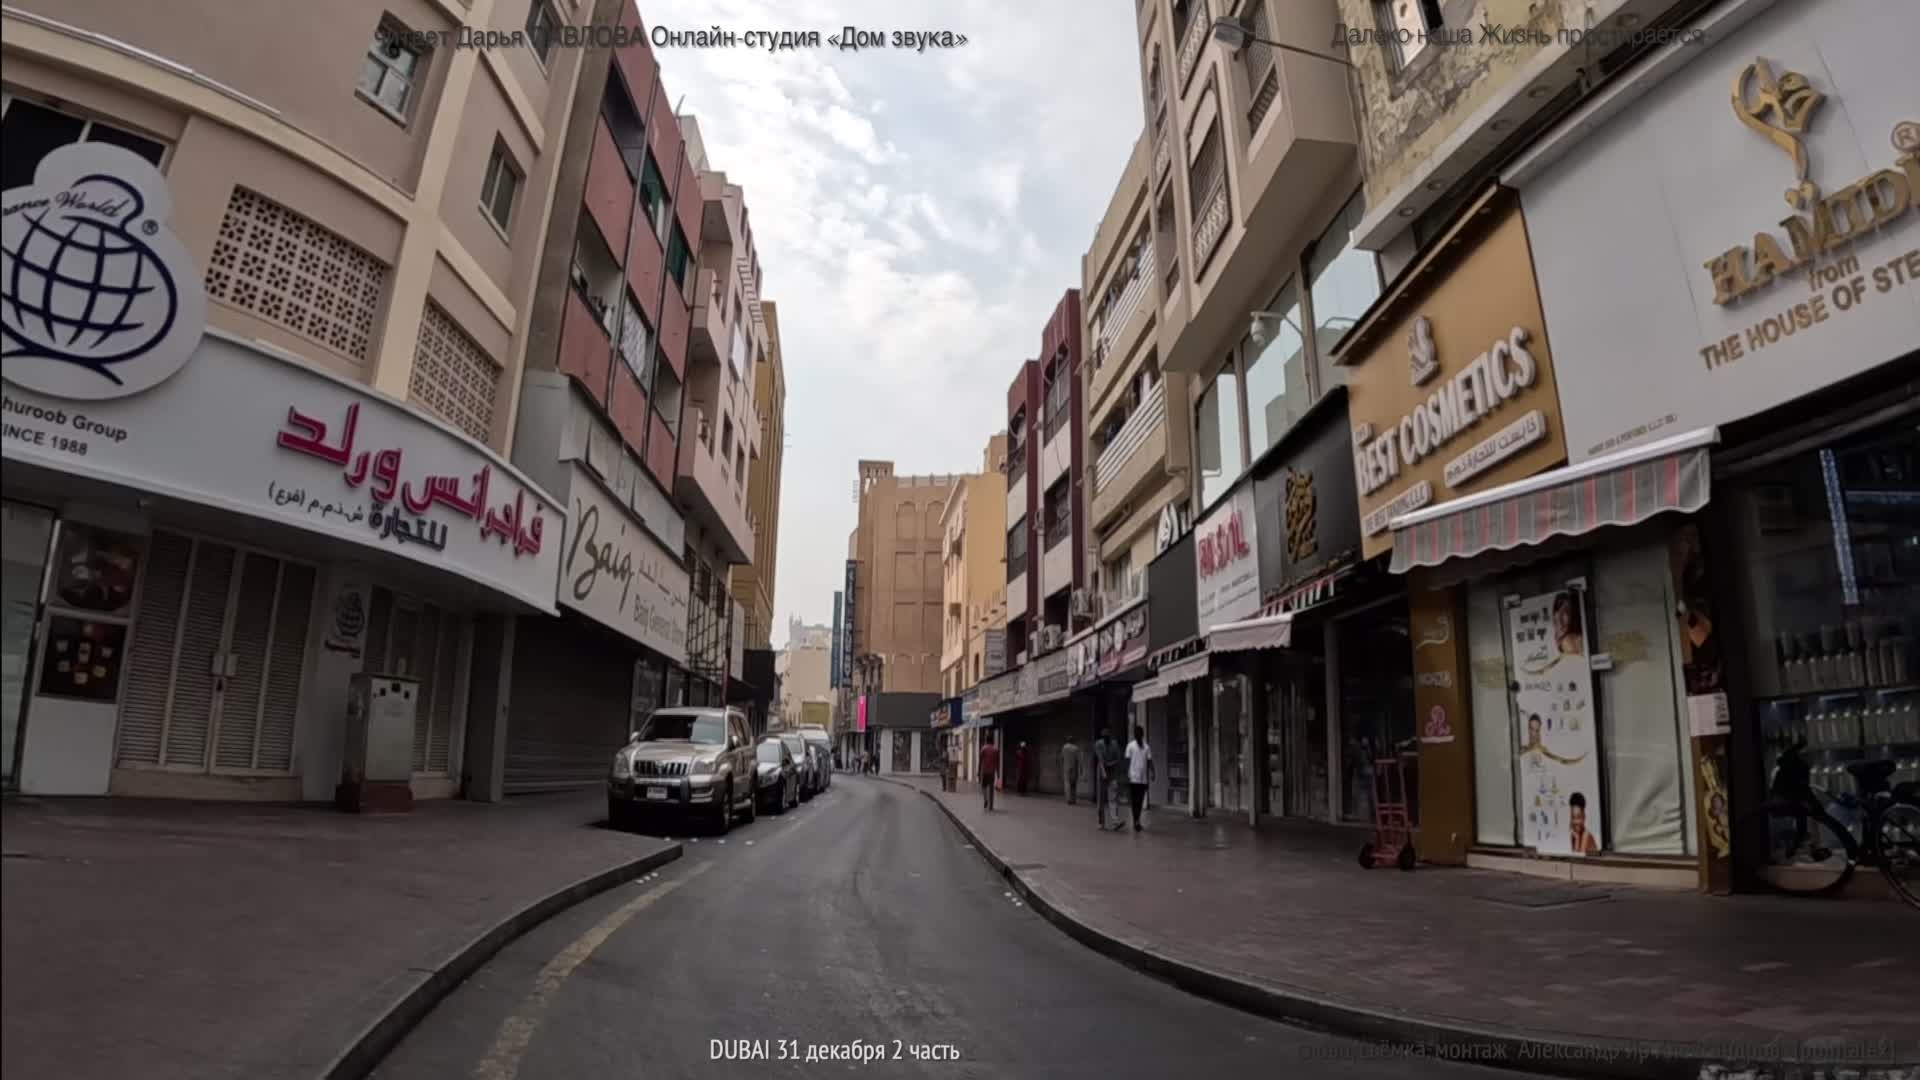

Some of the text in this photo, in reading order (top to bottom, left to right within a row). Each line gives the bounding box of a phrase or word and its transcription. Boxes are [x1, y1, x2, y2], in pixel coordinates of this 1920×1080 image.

[55, 190, 130, 218] World
[1700, 334, 1744, 371] THE
[1746, 297, 1830, 352] HOUSE
[1832, 276, 1866, 313] OF
[72, 415, 128, 443] Group
[1355, 426, 1402, 497] BEST
[1400, 325, 1538, 466] COSMETICS
[51, 435, 88, 456] 1988
[368, 502, 448, 552] للتجارة
[566, 497, 635, 615] Baig
